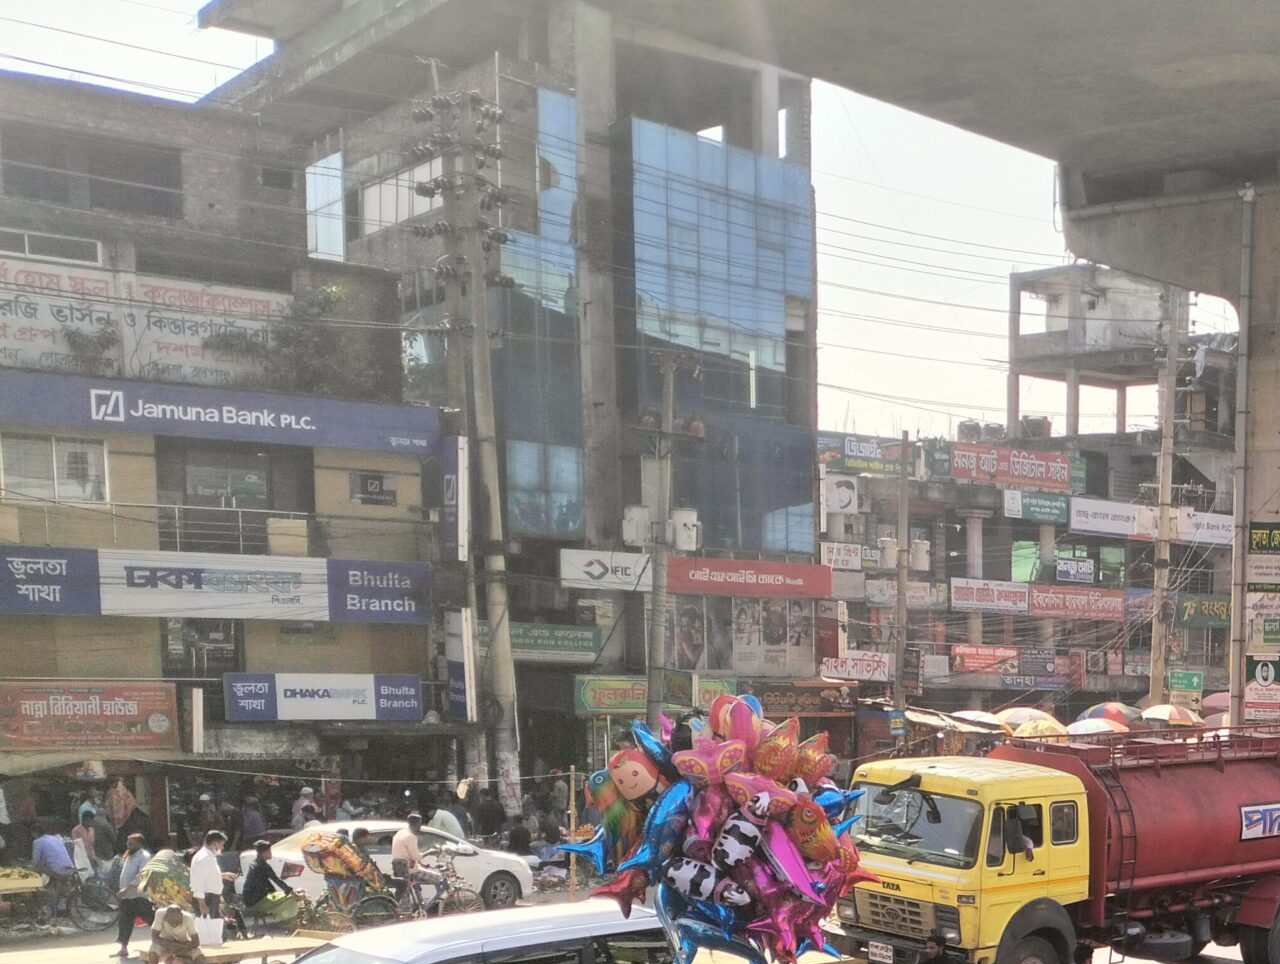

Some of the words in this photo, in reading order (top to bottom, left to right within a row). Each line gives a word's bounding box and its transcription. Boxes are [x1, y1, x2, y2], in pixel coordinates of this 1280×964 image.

[129, 399, 219, 424] Jamuna
[223, 405, 276, 428] Bank
[280, 414, 317, 431] PLC.
[1206, 522, 1221, 532] Bank
[1221, 522, 1233, 532] PLC
[348, 570, 412, 589] Bhulta
[16, 582, 61, 603] শাখা
[346, 594, 416, 612] Branch
[380, 685, 416, 696] Bhulta
[238, 698, 265, 711] শাখা
[380, 698, 418, 709] Branch
[881, 881, 901, 892] TATA
